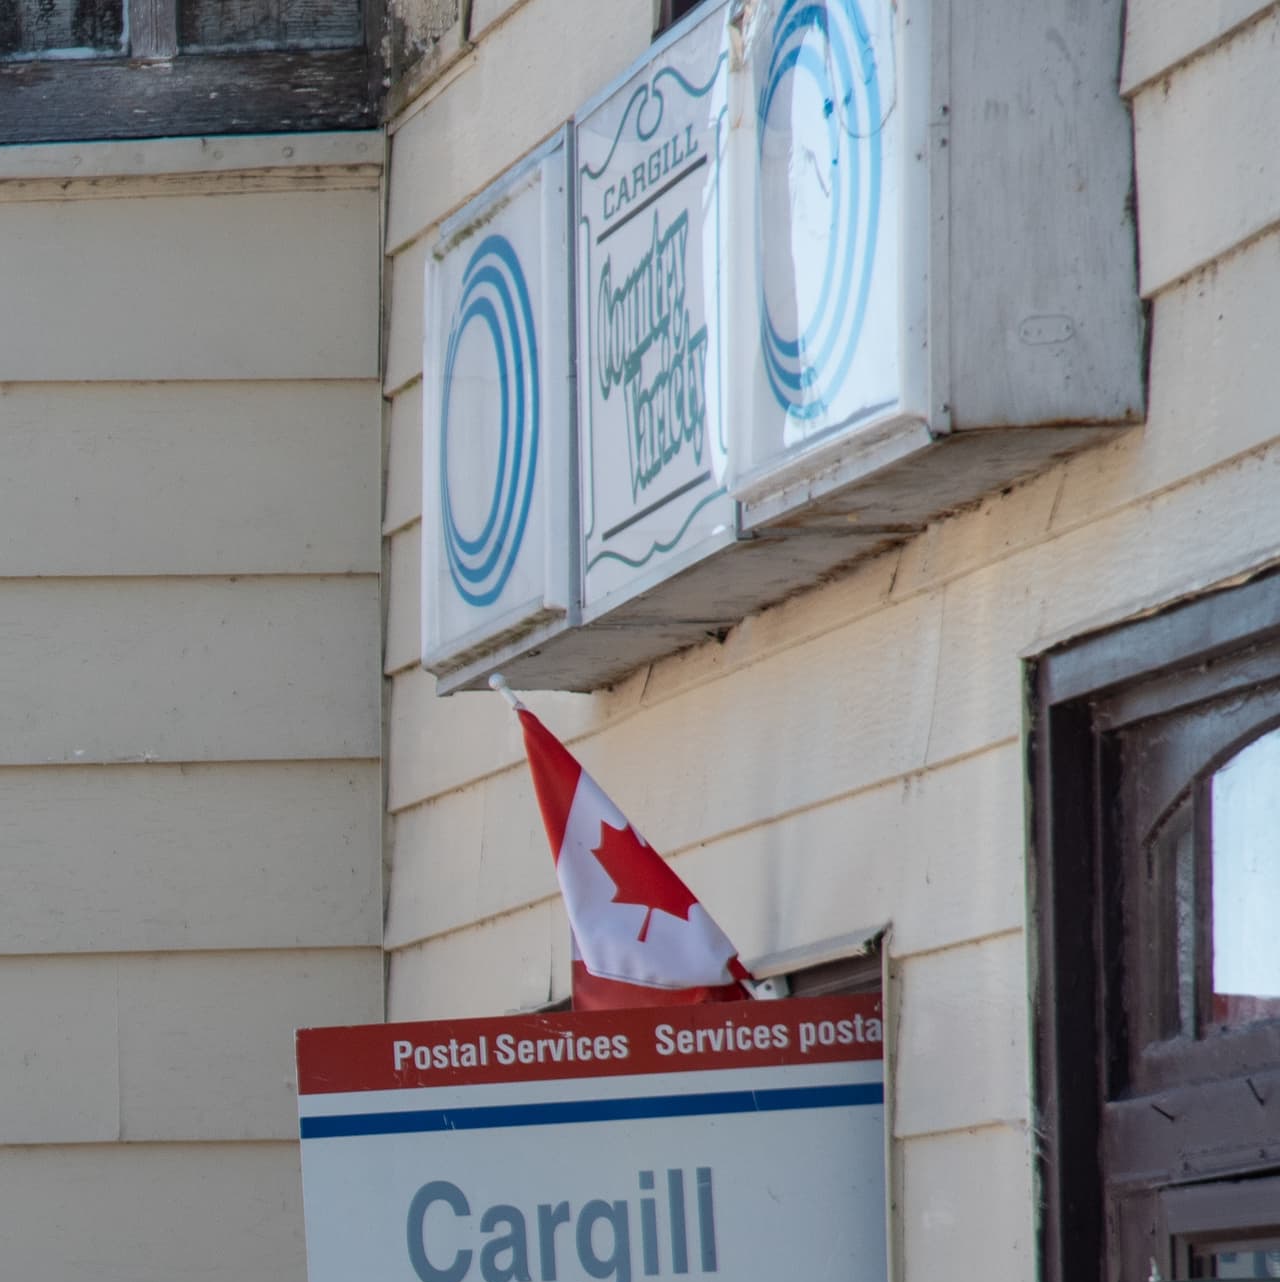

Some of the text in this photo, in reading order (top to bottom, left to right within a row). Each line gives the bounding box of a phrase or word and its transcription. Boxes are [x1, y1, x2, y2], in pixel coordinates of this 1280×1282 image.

[601, 123, 699, 221] CARGILL
[597, 207, 689, 401] Country
[623, 309, 709, 505] Variety
[392, 1035, 488, 1072] Postal
[495, 1030, 631, 1066] Services
[654, 1020, 790, 1057] Services
